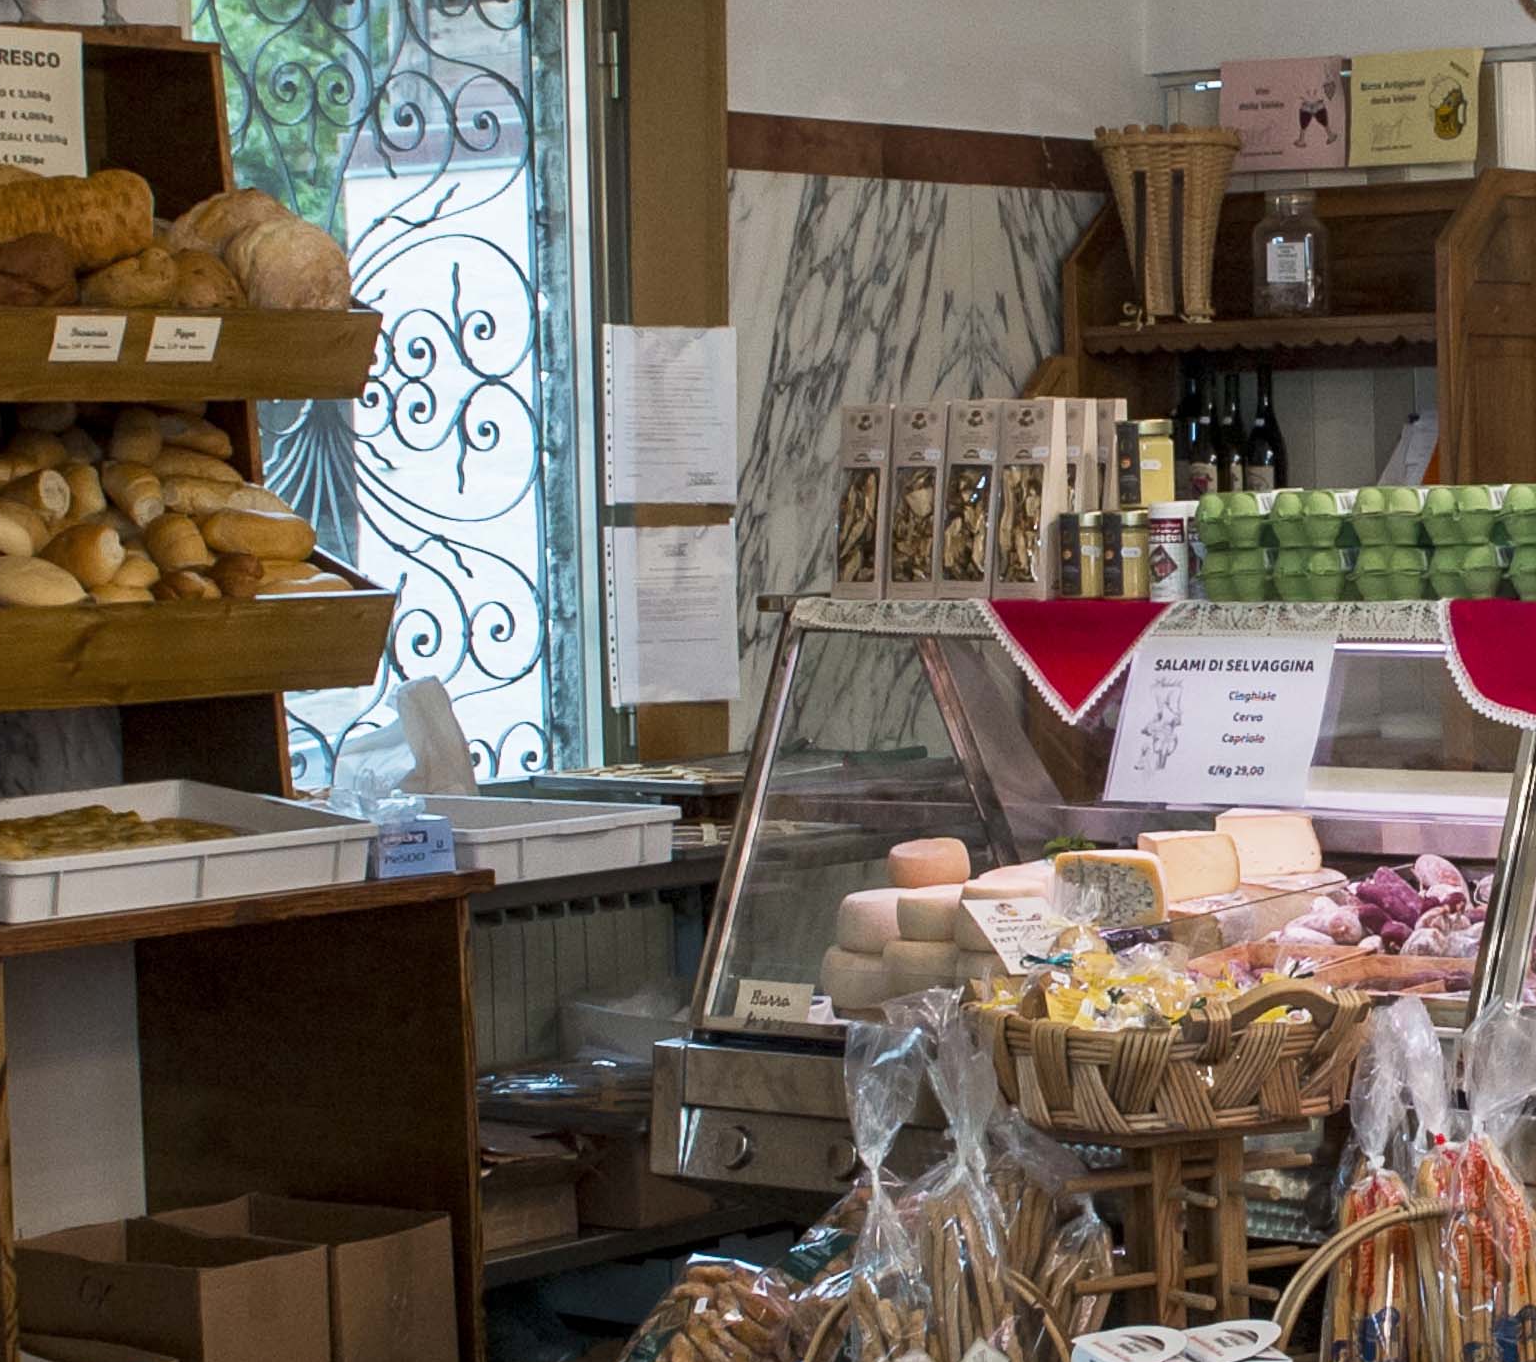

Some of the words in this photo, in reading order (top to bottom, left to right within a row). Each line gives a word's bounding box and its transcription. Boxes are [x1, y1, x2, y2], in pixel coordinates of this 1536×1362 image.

[1154, 659, 1205, 671] SALAMI
[1208, 659, 1223, 671] DI
[1225, 659, 1314, 672] SELVAGGINA
[1228, 690, 1277, 703] Cinghiale
[1232, 712, 1263, 722] Cervo
[1221, 733, 1265, 744] Capriolo
[1233, 765, 1264, 776] 29,00
